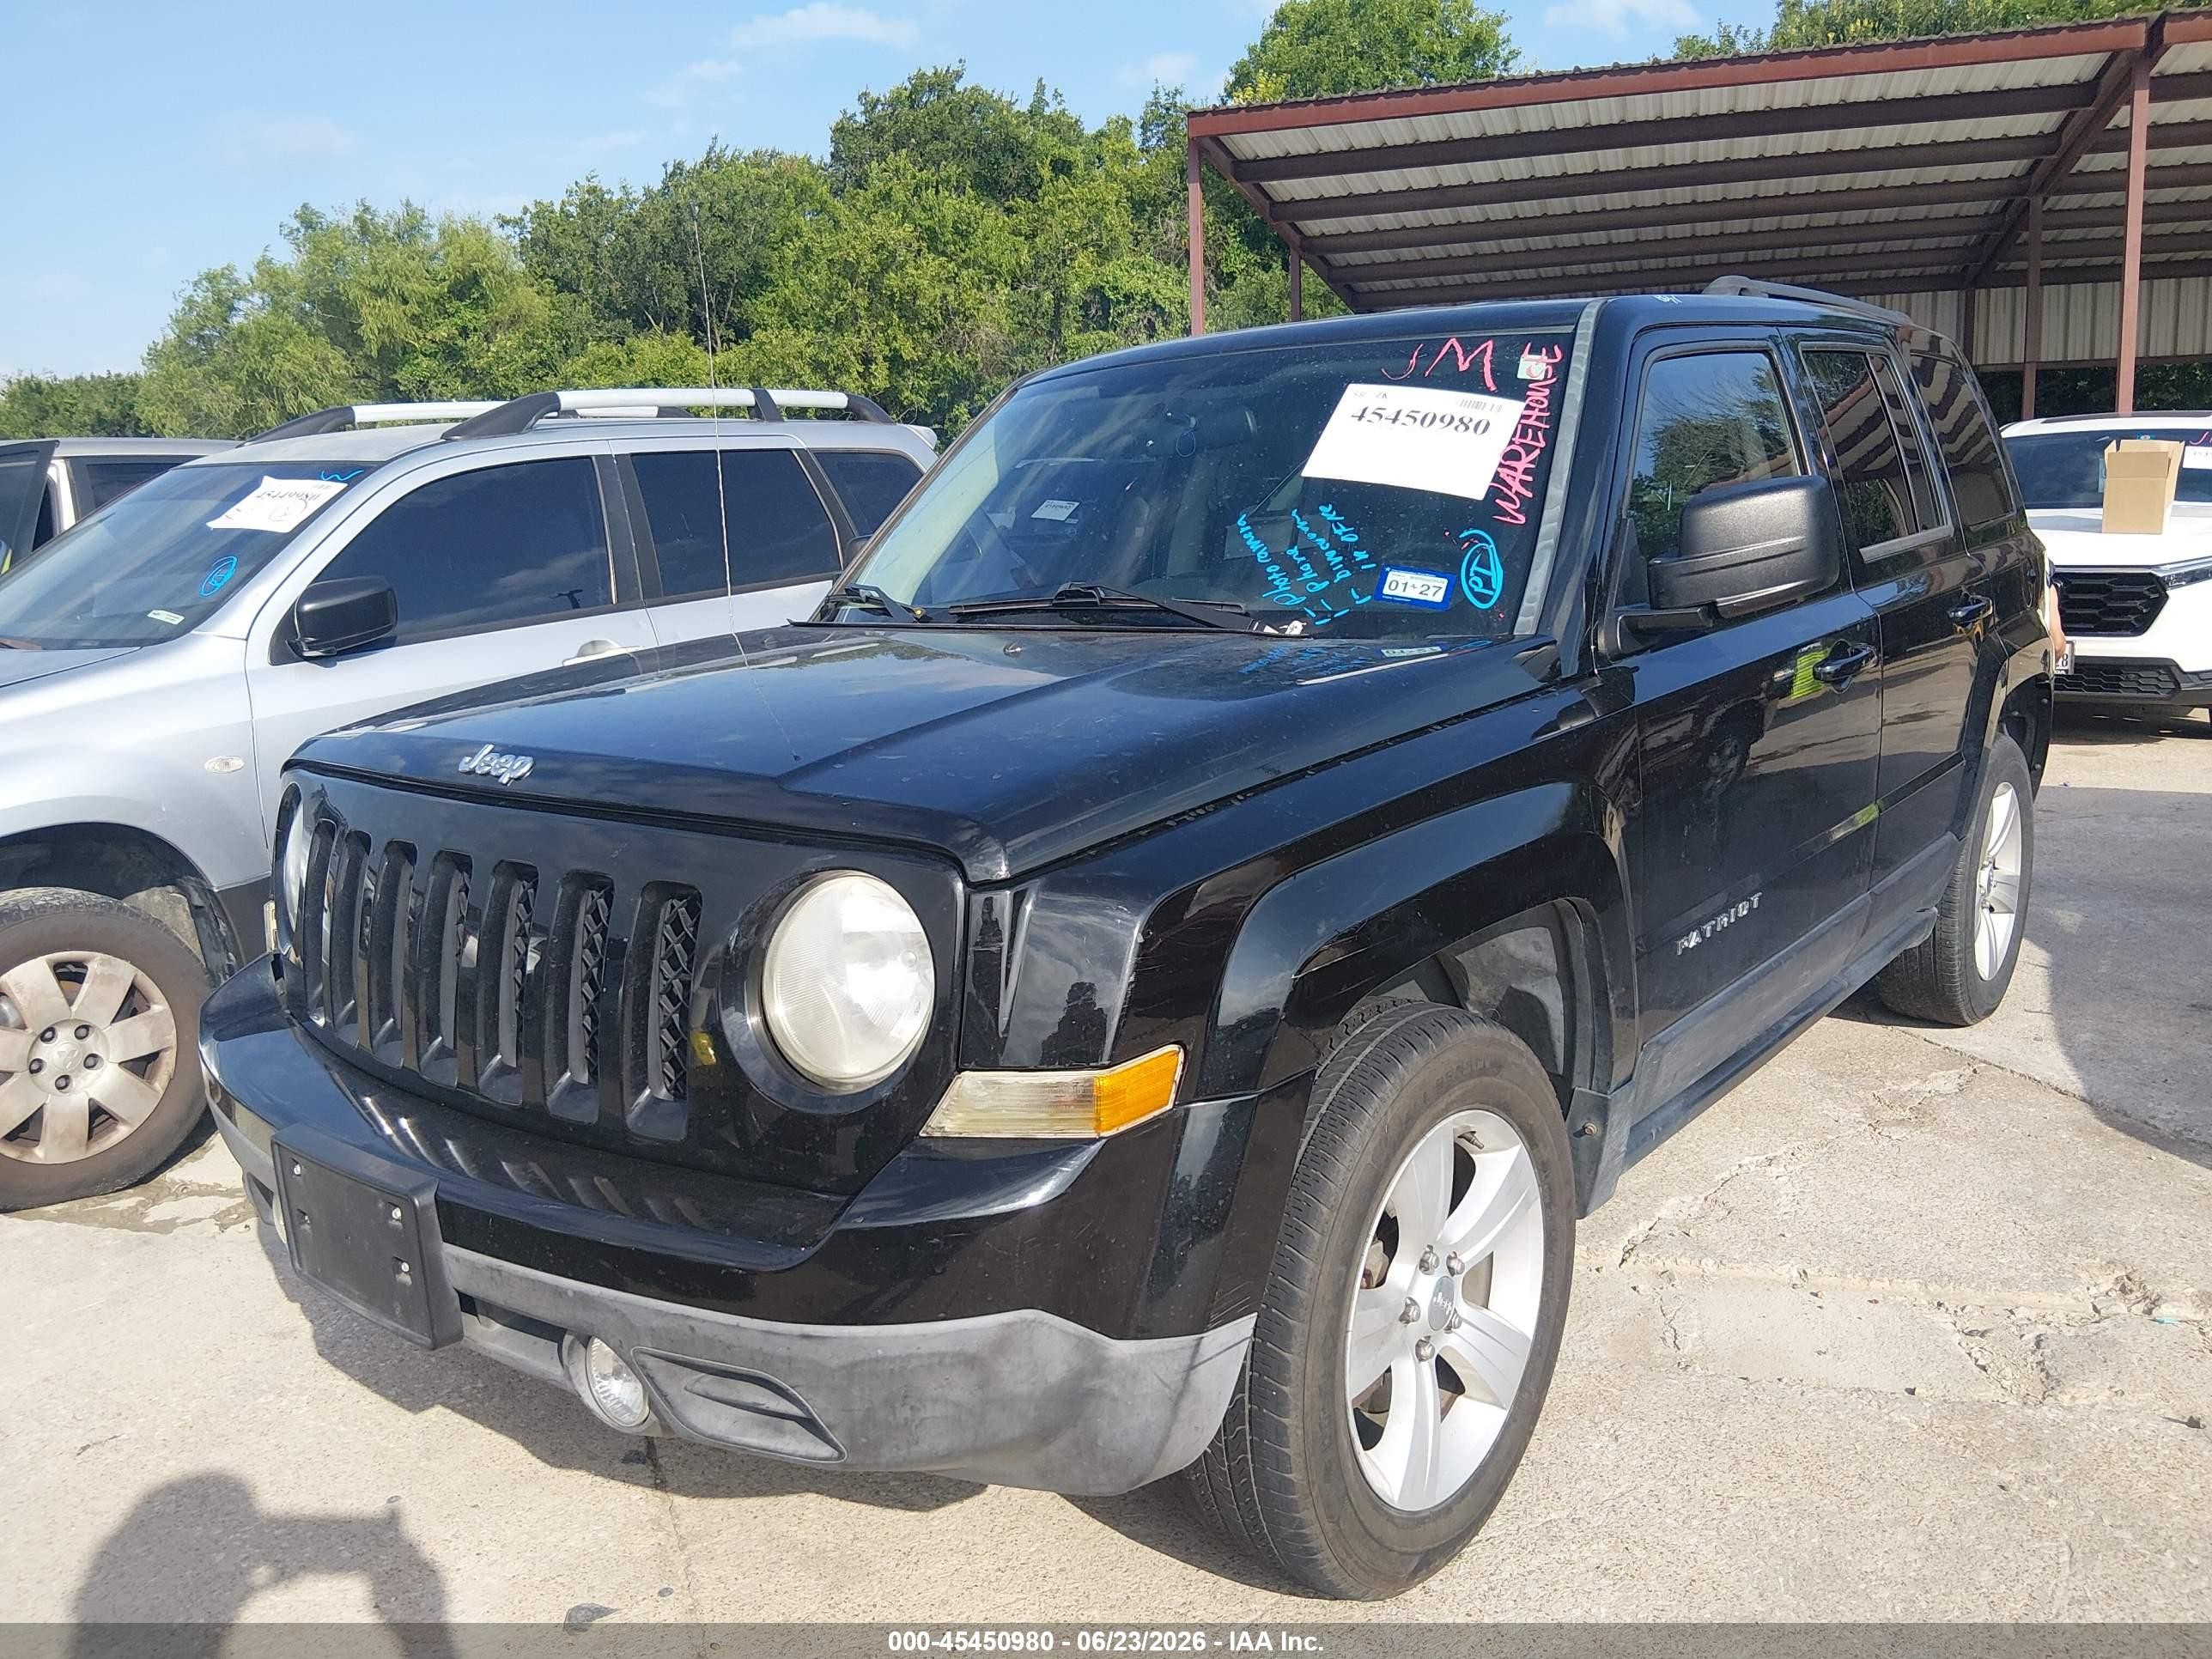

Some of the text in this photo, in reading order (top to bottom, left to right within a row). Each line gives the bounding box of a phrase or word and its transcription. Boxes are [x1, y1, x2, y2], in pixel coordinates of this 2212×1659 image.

[1351, 405, 1492, 436] 45450980
[1492, 342, 1564, 526] WAREHOUSE
[458, 744, 535, 786] Jeep
[1676, 891, 1763, 956] PATRIOT
